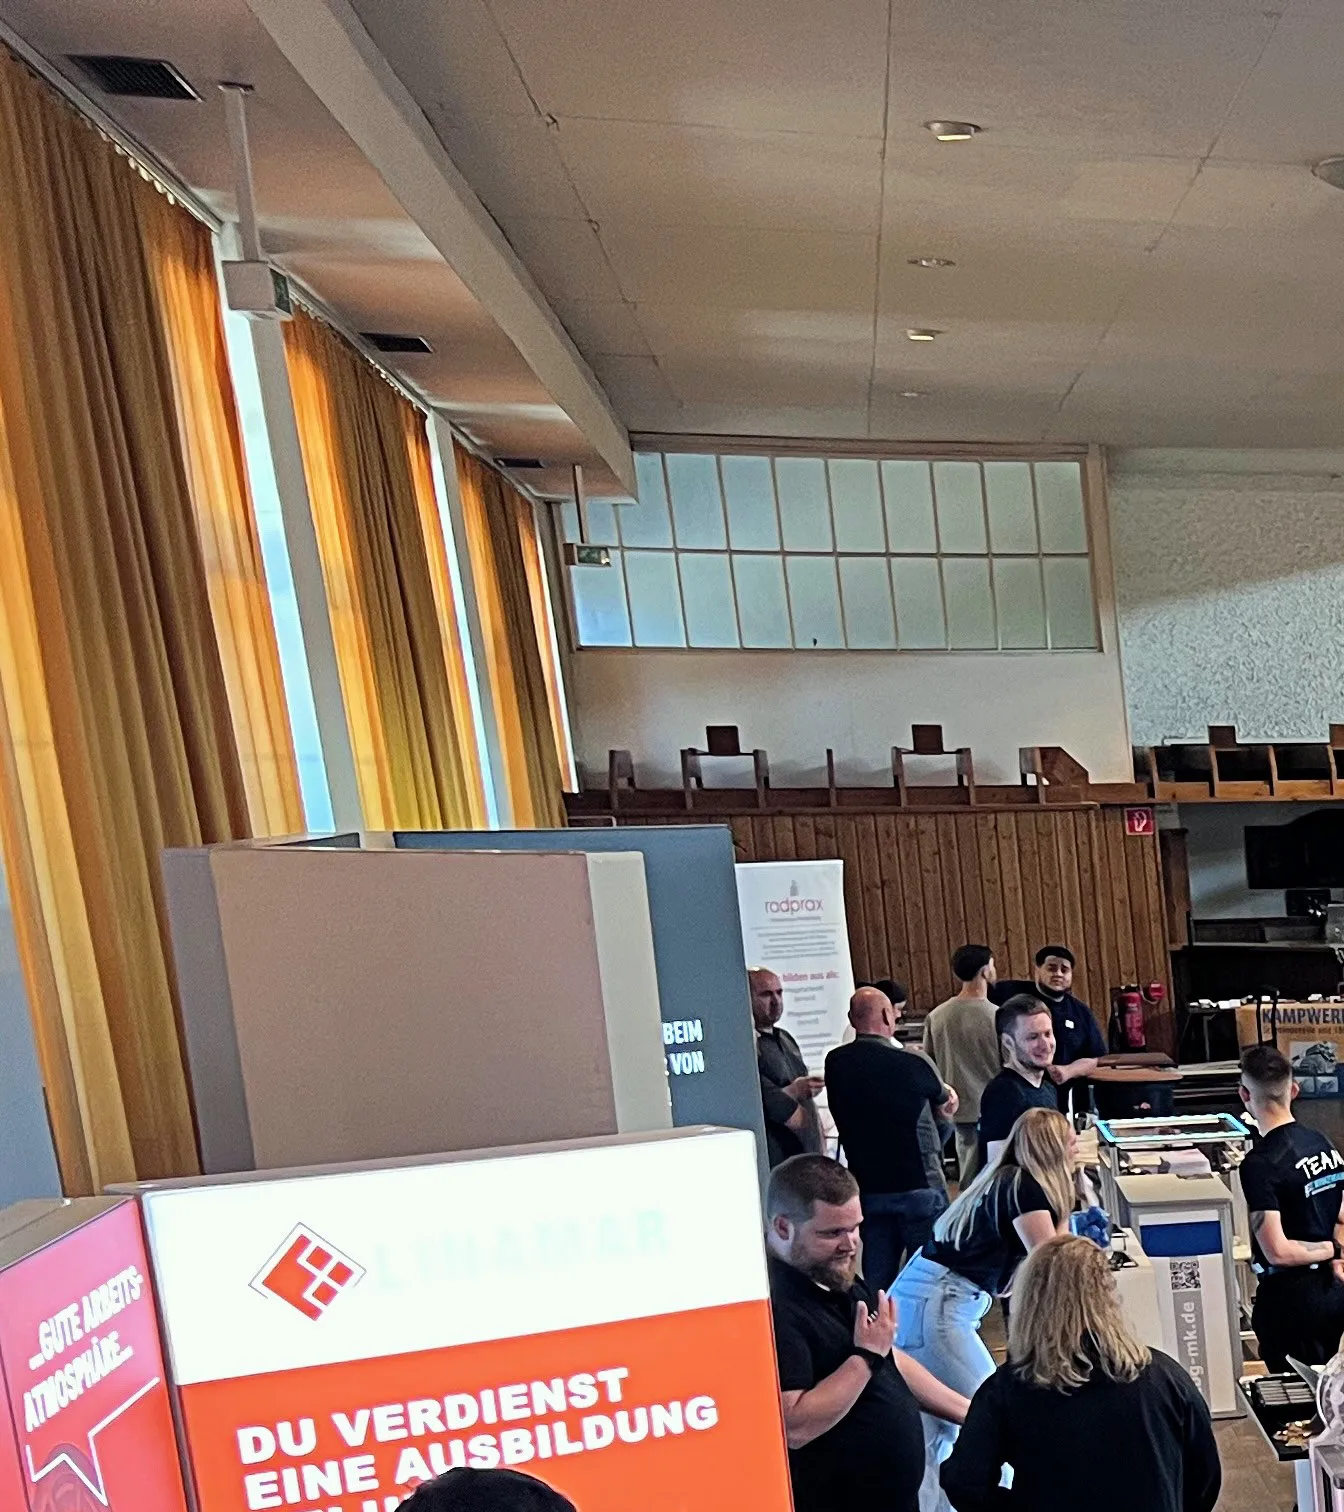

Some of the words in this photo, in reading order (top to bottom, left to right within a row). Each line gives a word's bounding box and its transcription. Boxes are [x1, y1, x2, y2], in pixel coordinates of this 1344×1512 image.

[765, 898, 824, 915] radprax
[662, 1019, 703, 1044] BEIM
[669, 1050, 705, 1075] VON
[236, 1418, 317, 1465] DU
[332, 1367, 628, 1447] VERDIENST
[243, 1454, 379, 1511] EINE
[394, 1396, 718, 1485] AUSBILDUNG
